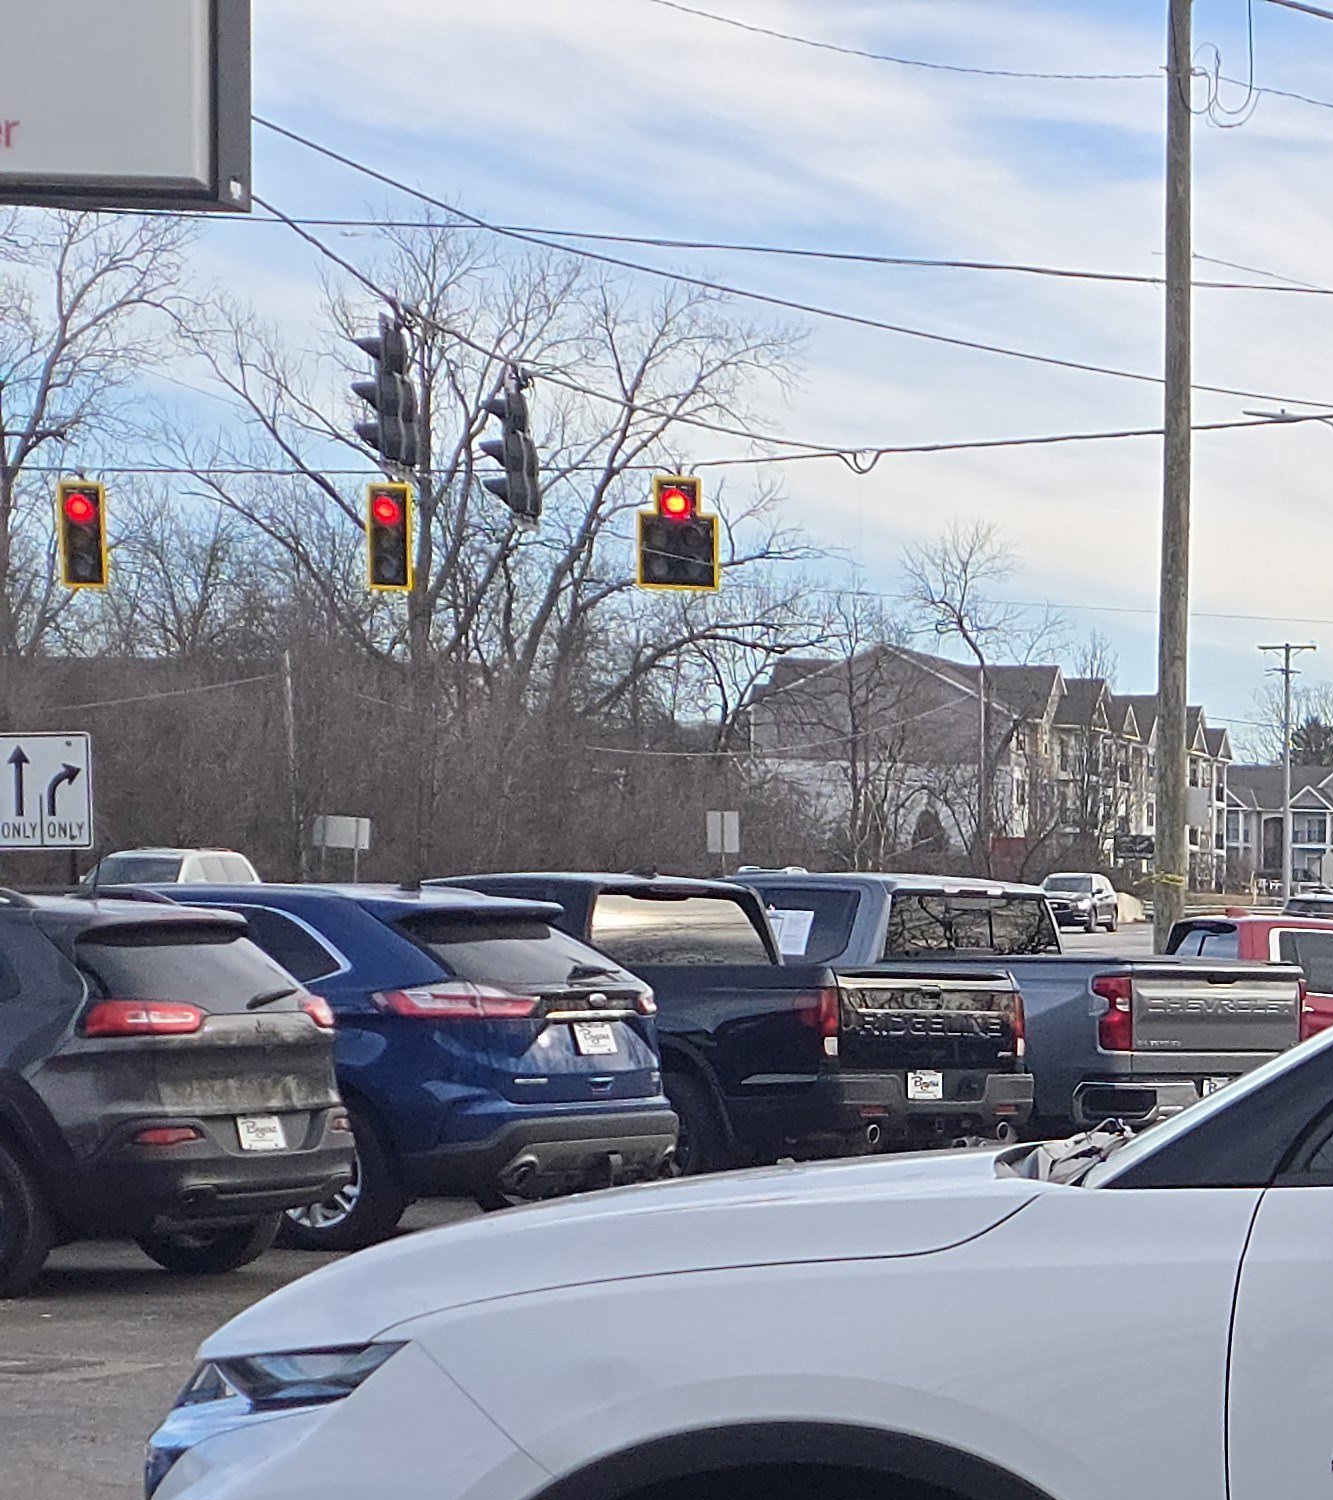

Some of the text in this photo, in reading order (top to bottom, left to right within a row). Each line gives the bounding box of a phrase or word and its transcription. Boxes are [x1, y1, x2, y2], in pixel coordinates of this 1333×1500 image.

[1, 821, 38, 839] ONLY
[47, 821, 85, 841] ONLY
[1148, 999, 1294, 1013] CHEVROLET
[859, 1015, 1003, 1037] RIDGELINE
